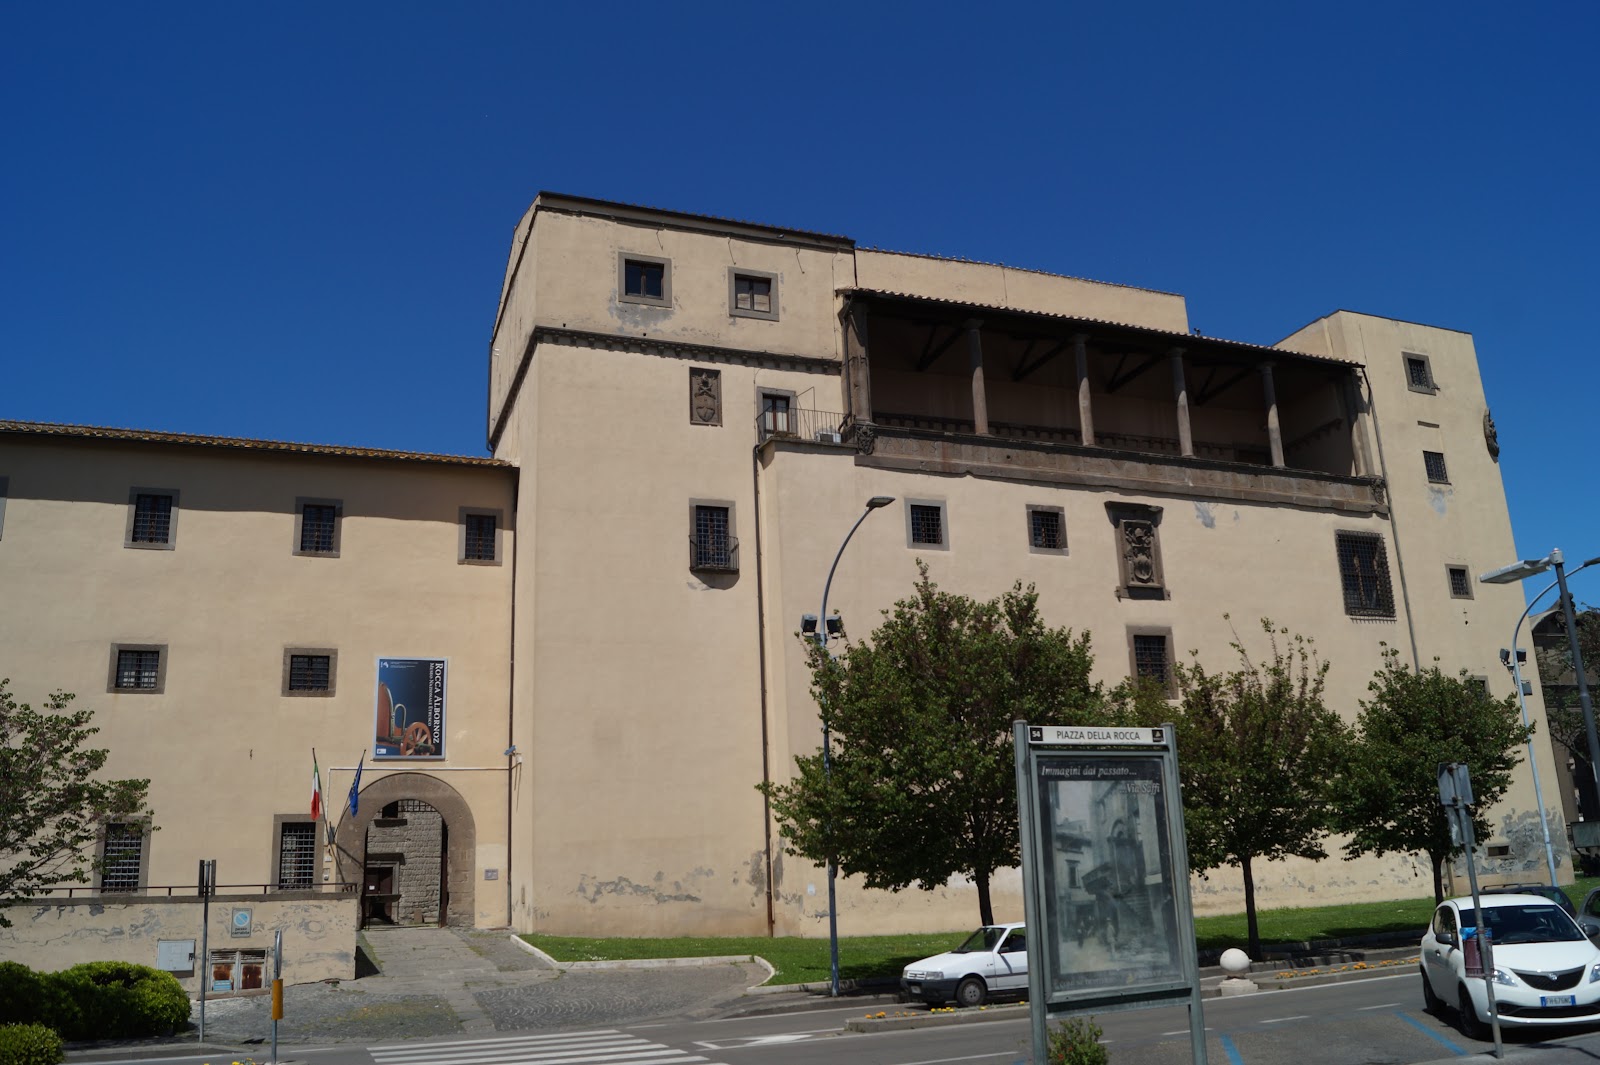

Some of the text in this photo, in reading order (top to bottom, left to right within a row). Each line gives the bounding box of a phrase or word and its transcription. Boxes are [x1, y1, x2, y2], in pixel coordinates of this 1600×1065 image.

[433, 662, 443, 744] ROCCA ALBORNOZ
[1056, 730, 1085, 740] PIAZZA
[1087, 731, 1111, 740] DELLA
[1113, 731, 1141, 740] ROCCA
[1041, 765, 1082, 778] Immagini
